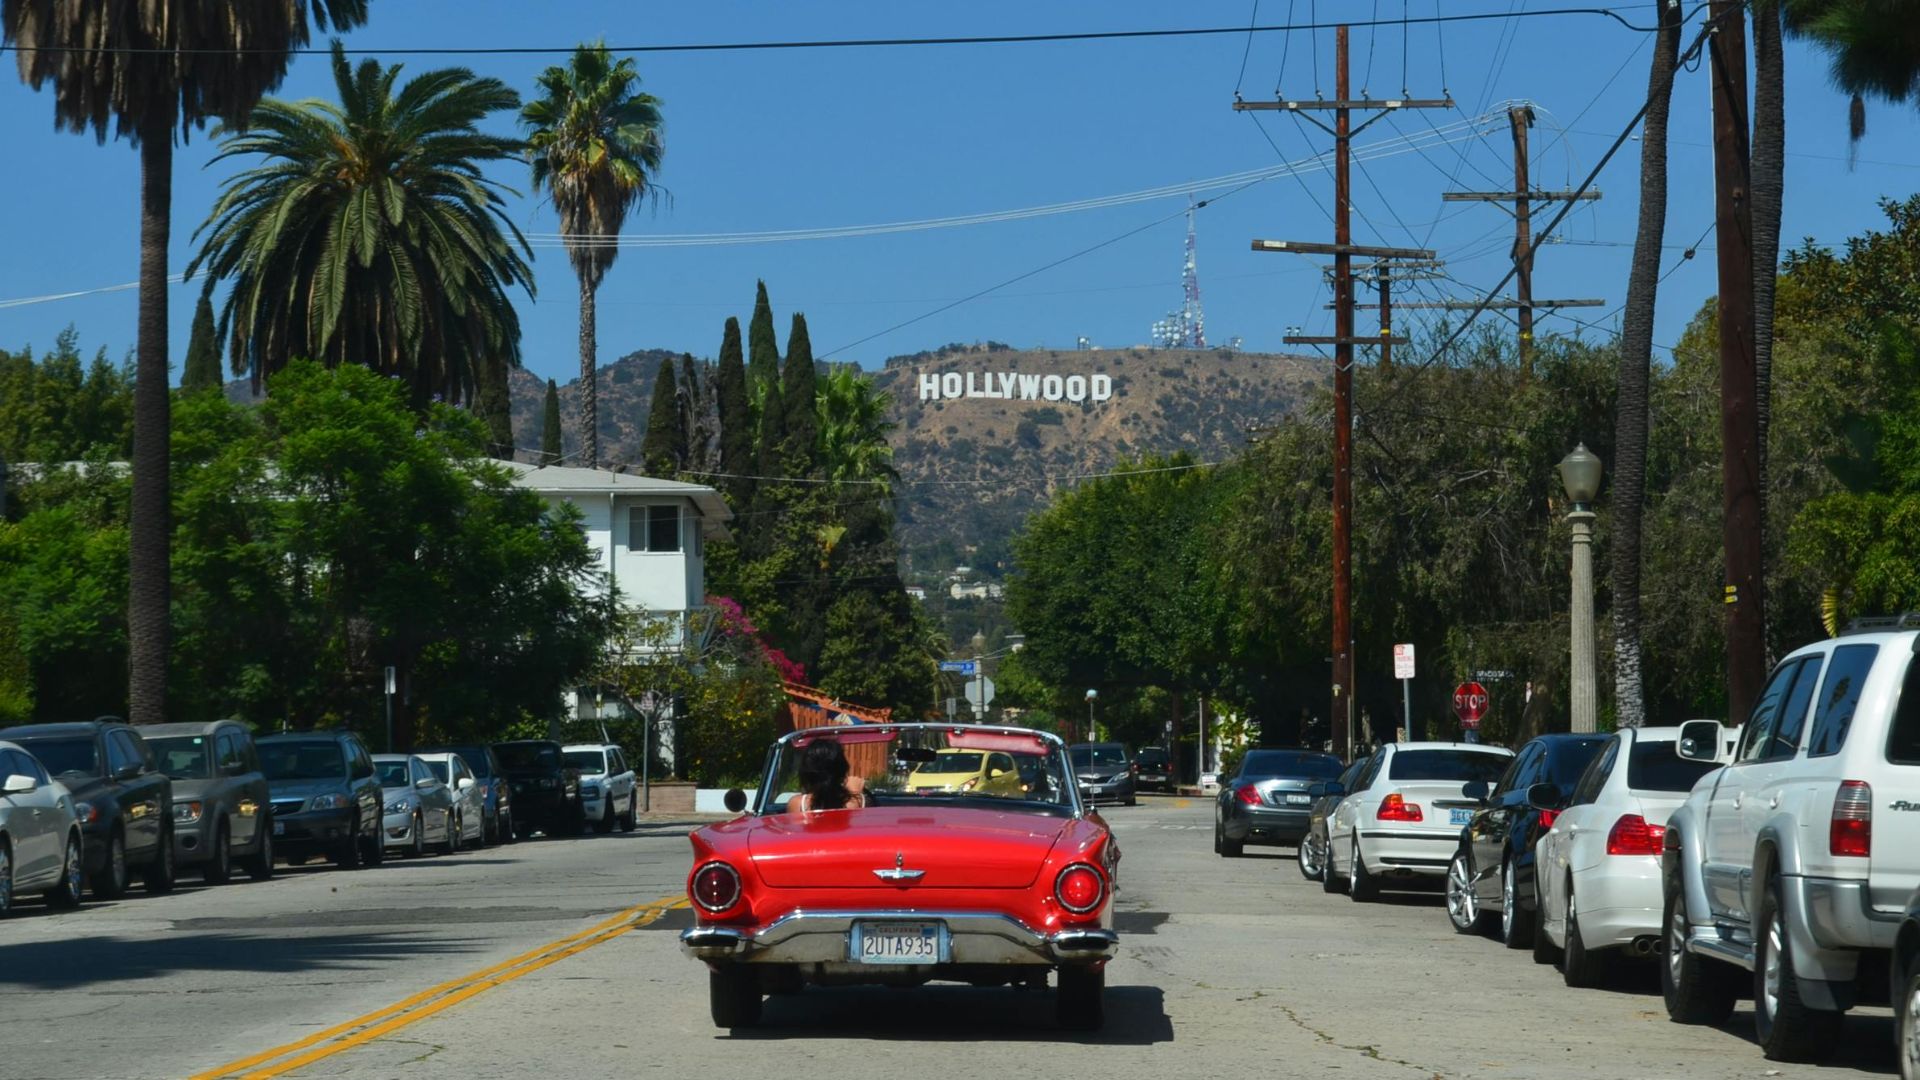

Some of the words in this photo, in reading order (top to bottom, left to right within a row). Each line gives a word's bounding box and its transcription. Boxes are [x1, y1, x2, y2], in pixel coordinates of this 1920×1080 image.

[919, 372, 1112, 401] HOLLYWOOD
[1455, 694, 1487, 709] STOP
[865, 936, 933, 955] 2UTA935
